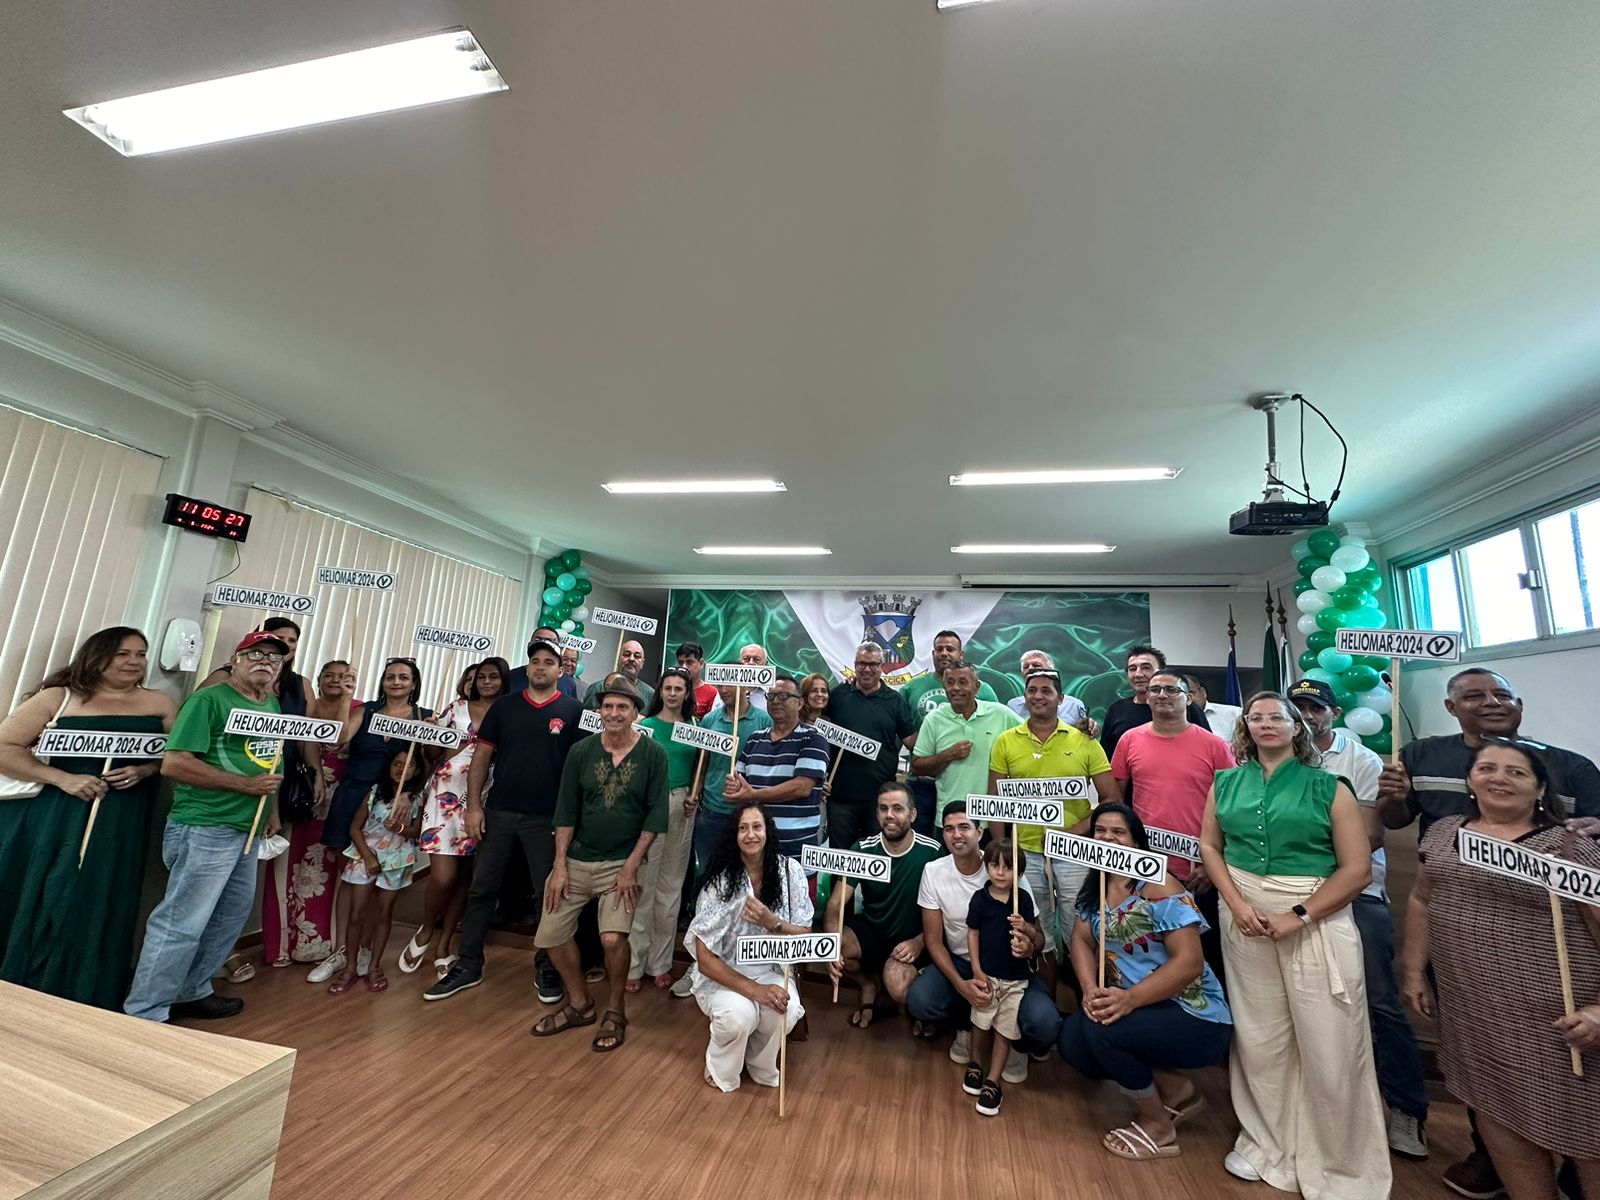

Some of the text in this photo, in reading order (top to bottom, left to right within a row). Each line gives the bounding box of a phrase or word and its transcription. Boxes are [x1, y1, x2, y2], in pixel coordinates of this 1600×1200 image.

[319, 569, 356, 584] HELIOMAR
[357, 573, 375, 587] 2024
[218, 587, 267, 605] HELIOMAR
[268, 594, 291, 609] 2024
[595, 610, 624, 626] HELIOMAR
[624, 617, 641, 630] 2024
[417, 627, 455, 645] HELIOMAR
[455, 633, 474, 648] 2024
[1340, 632, 1394, 653] HELIOMAR
[1395, 635, 1424, 655] 2024
[708, 666, 739, 683] HELIOMAR
[739, 668, 757, 684] 2024
[230, 713, 288, 735] HELIOMAR
[287, 721, 314, 736] 2024
[374, 717, 418, 737] HELIOMAR
[417, 725, 438, 741] 2024
[45, 733, 115, 753] HELIOMAR
[116, 737, 142, 754] 2024
[674, 723, 705, 744] HELIOMAR
[703, 732, 721, 750] 2024
[846, 735, 863, 750] 2024
[1001, 781, 1043, 797] HELIOMAR
[1042, 781, 1063, 797] 2024
[970, 799, 1017, 818] HELIOMAR
[1016, 803, 1039, 821] 2024
[1050, 835, 1103, 865] HELIOMAR
[1105, 849, 1132, 872] 2024
[1147, 830, 1192, 856] HELIOMAR
[805, 850, 846, 873] HELIOMAR
[846, 857, 867, 875] 2024
[1468, 837, 1553, 887] HELIOMAR
[741, 939, 790, 960] HELIOMAR
[791, 939, 813, 957] 2024
